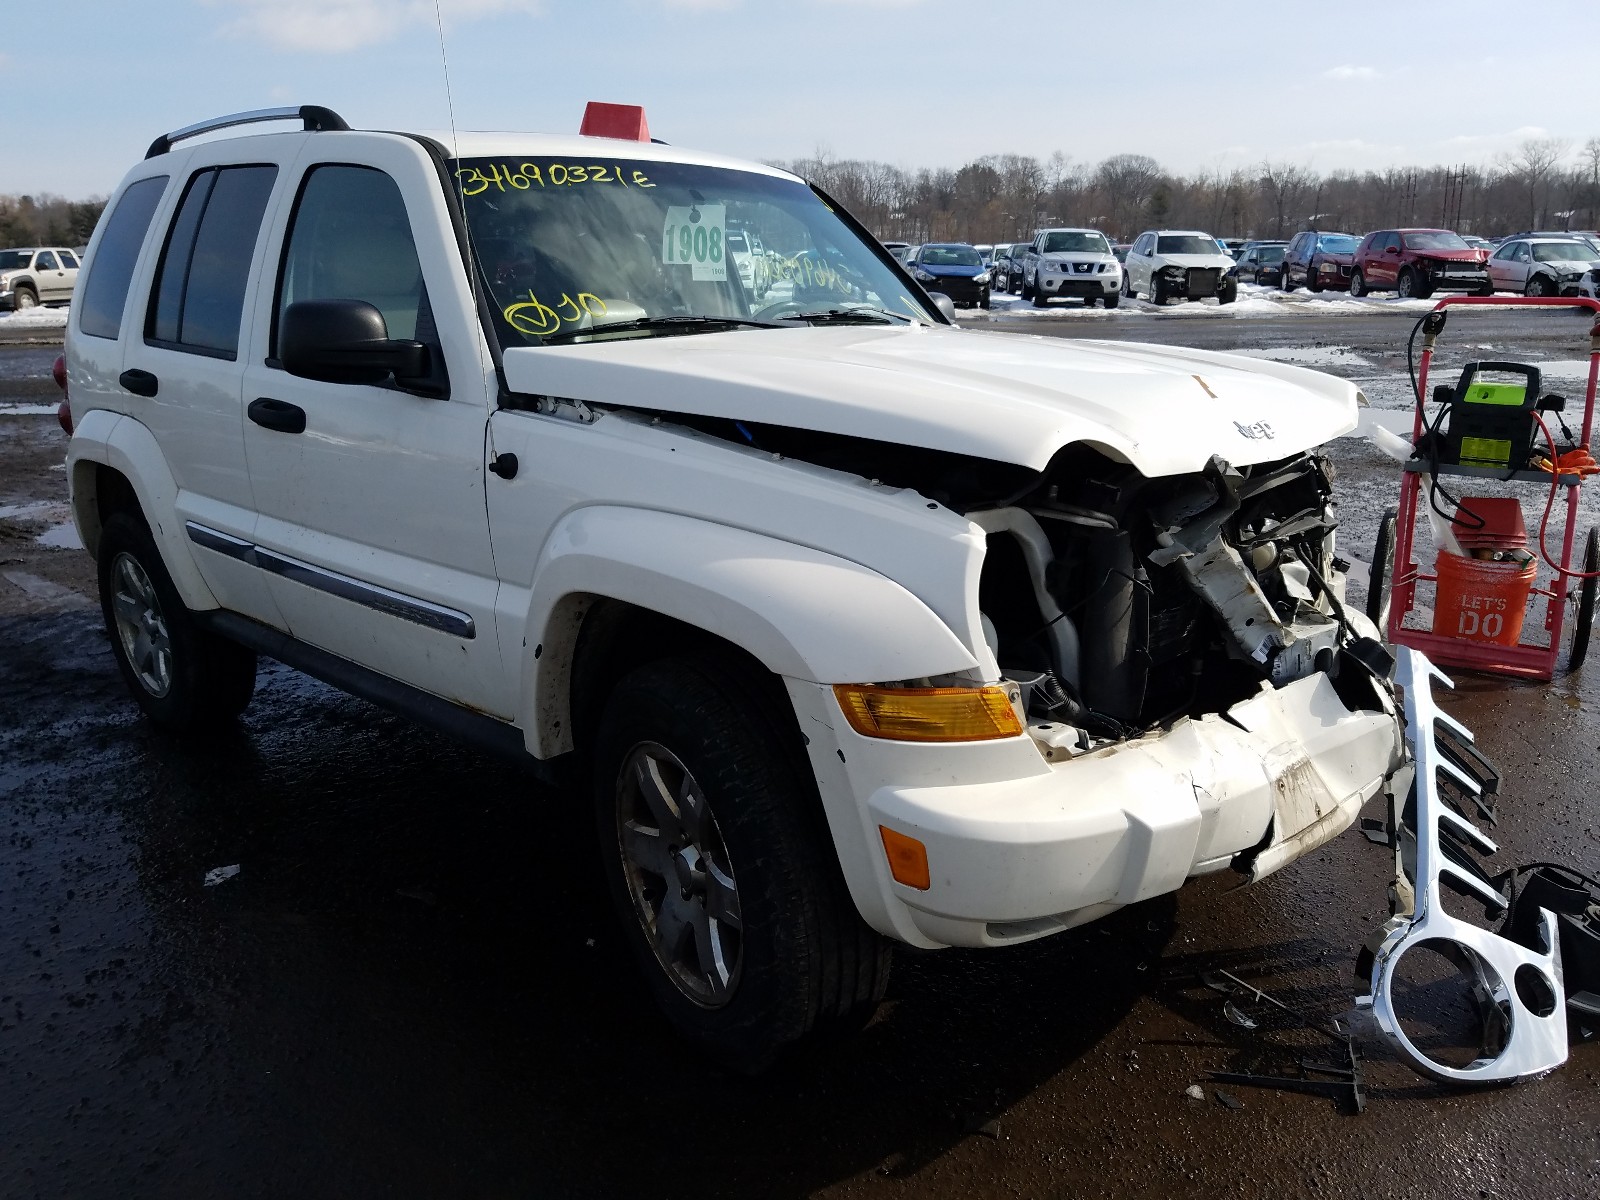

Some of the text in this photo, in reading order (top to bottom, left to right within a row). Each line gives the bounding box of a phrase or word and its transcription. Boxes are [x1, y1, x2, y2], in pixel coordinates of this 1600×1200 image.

[666, 224, 722, 264] 1908
[1462, 594, 1507, 611] LET'S
[1458, 610, 1503, 638] DO
